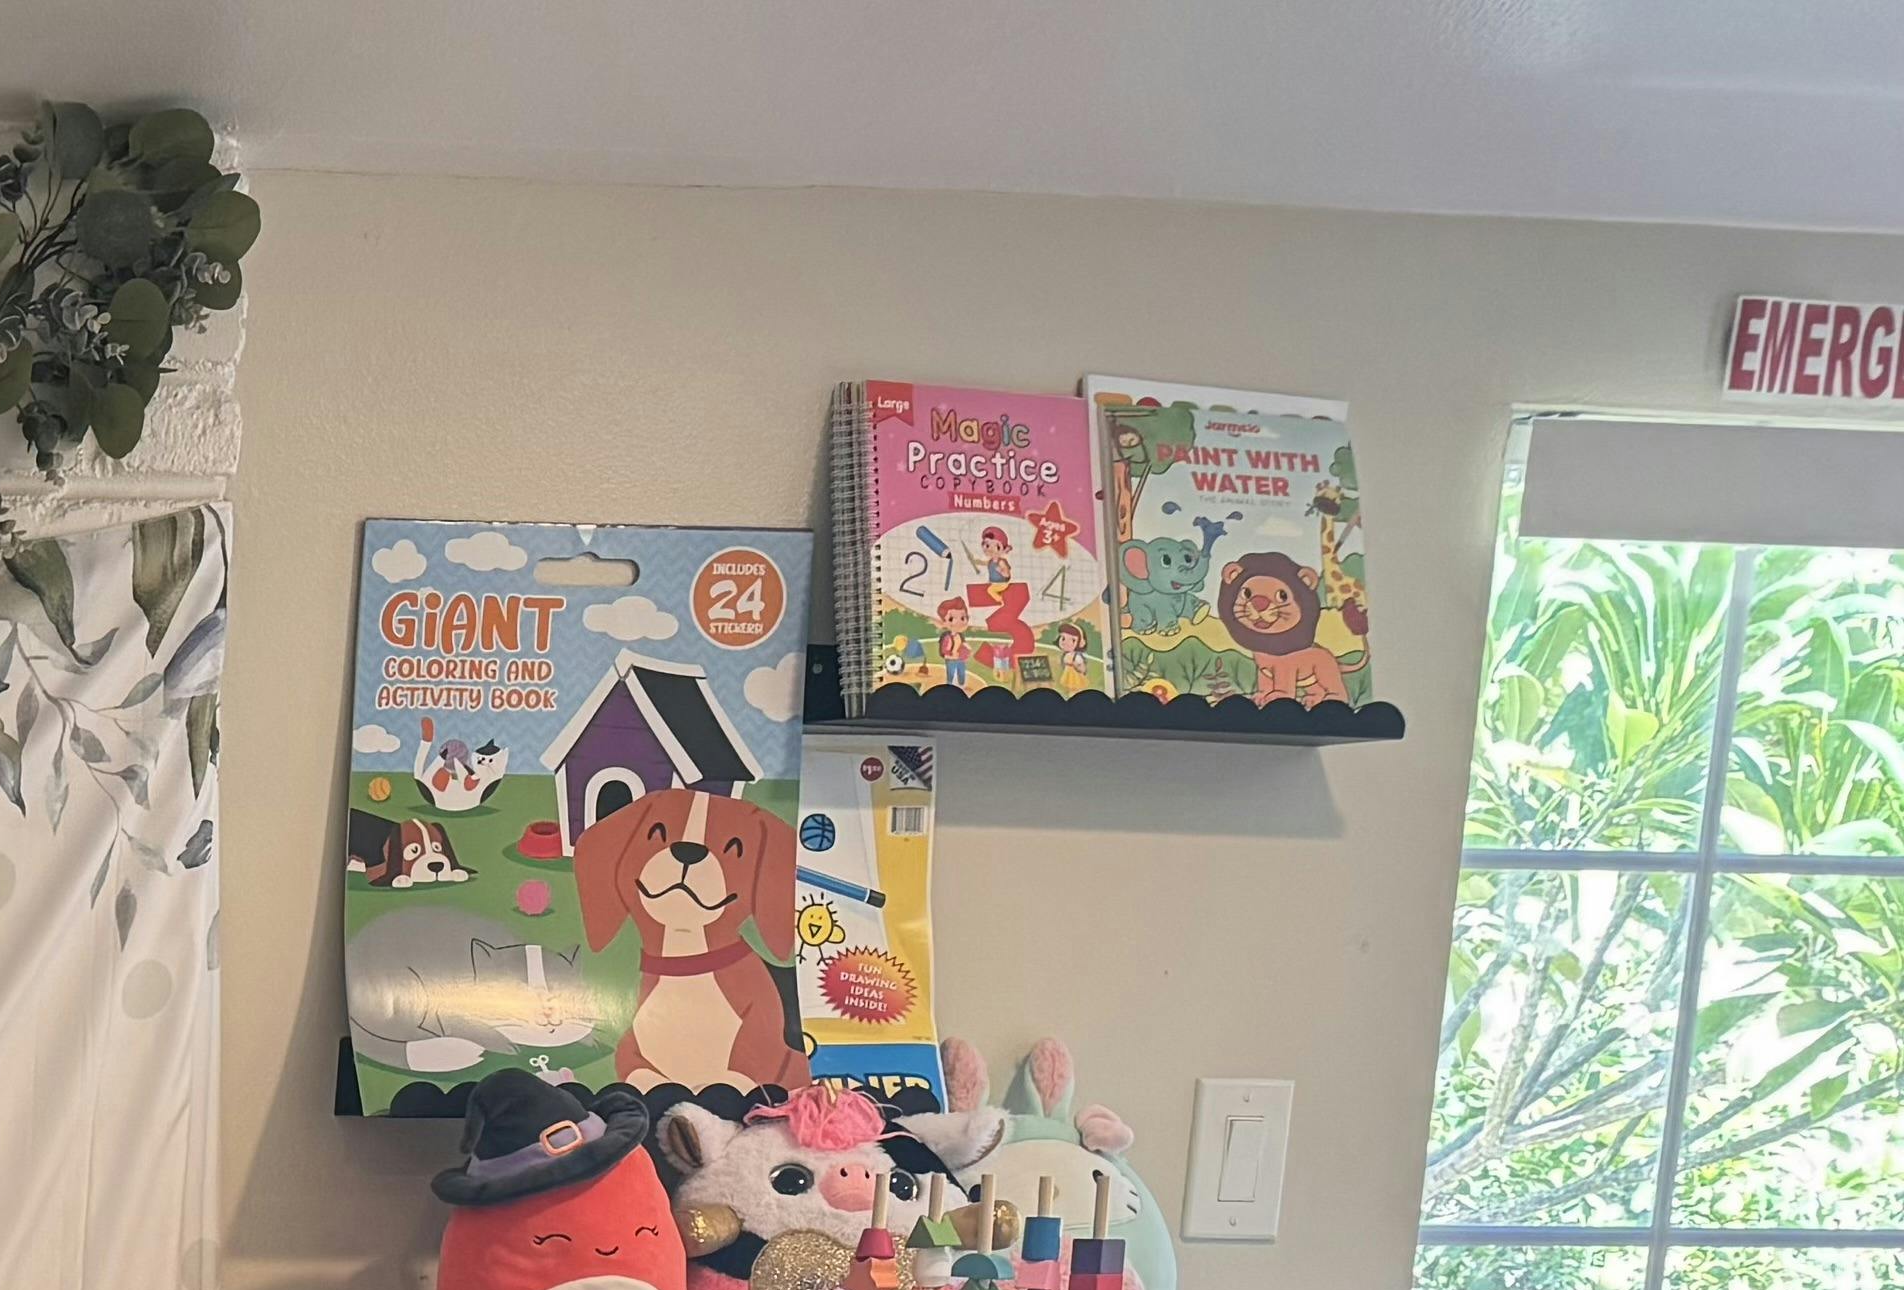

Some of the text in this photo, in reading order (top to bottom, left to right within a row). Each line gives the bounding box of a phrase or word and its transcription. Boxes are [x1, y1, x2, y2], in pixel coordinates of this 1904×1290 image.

[1728, 299, 1904, 399] EMERG
[878, 396, 910, 413] Large
[930, 407, 1031, 450] Magic
[907, 440, 1059, 484] Practice
[1156, 443, 1320, 472] PAINT WITH
[921, 474, 1046, 497] COPYBOOK
[1191, 471, 1290, 497] WATER
[953, 495, 1016, 511] Numbers
[712, 563, 765, 578] INCLUDES
[899, 551, 929, 598] 2
[707, 578, 765, 621] 24
[384, 657, 553, 683] COLORING AND
[376, 684, 557, 710] ACTIVITY BOOK
[840, 972, 897, 990] DRAWING
[858, 963, 882, 974] FUN
[844, 996, 888, 1012] INSIDE!
[850, 986, 884, 999] IDEAS
